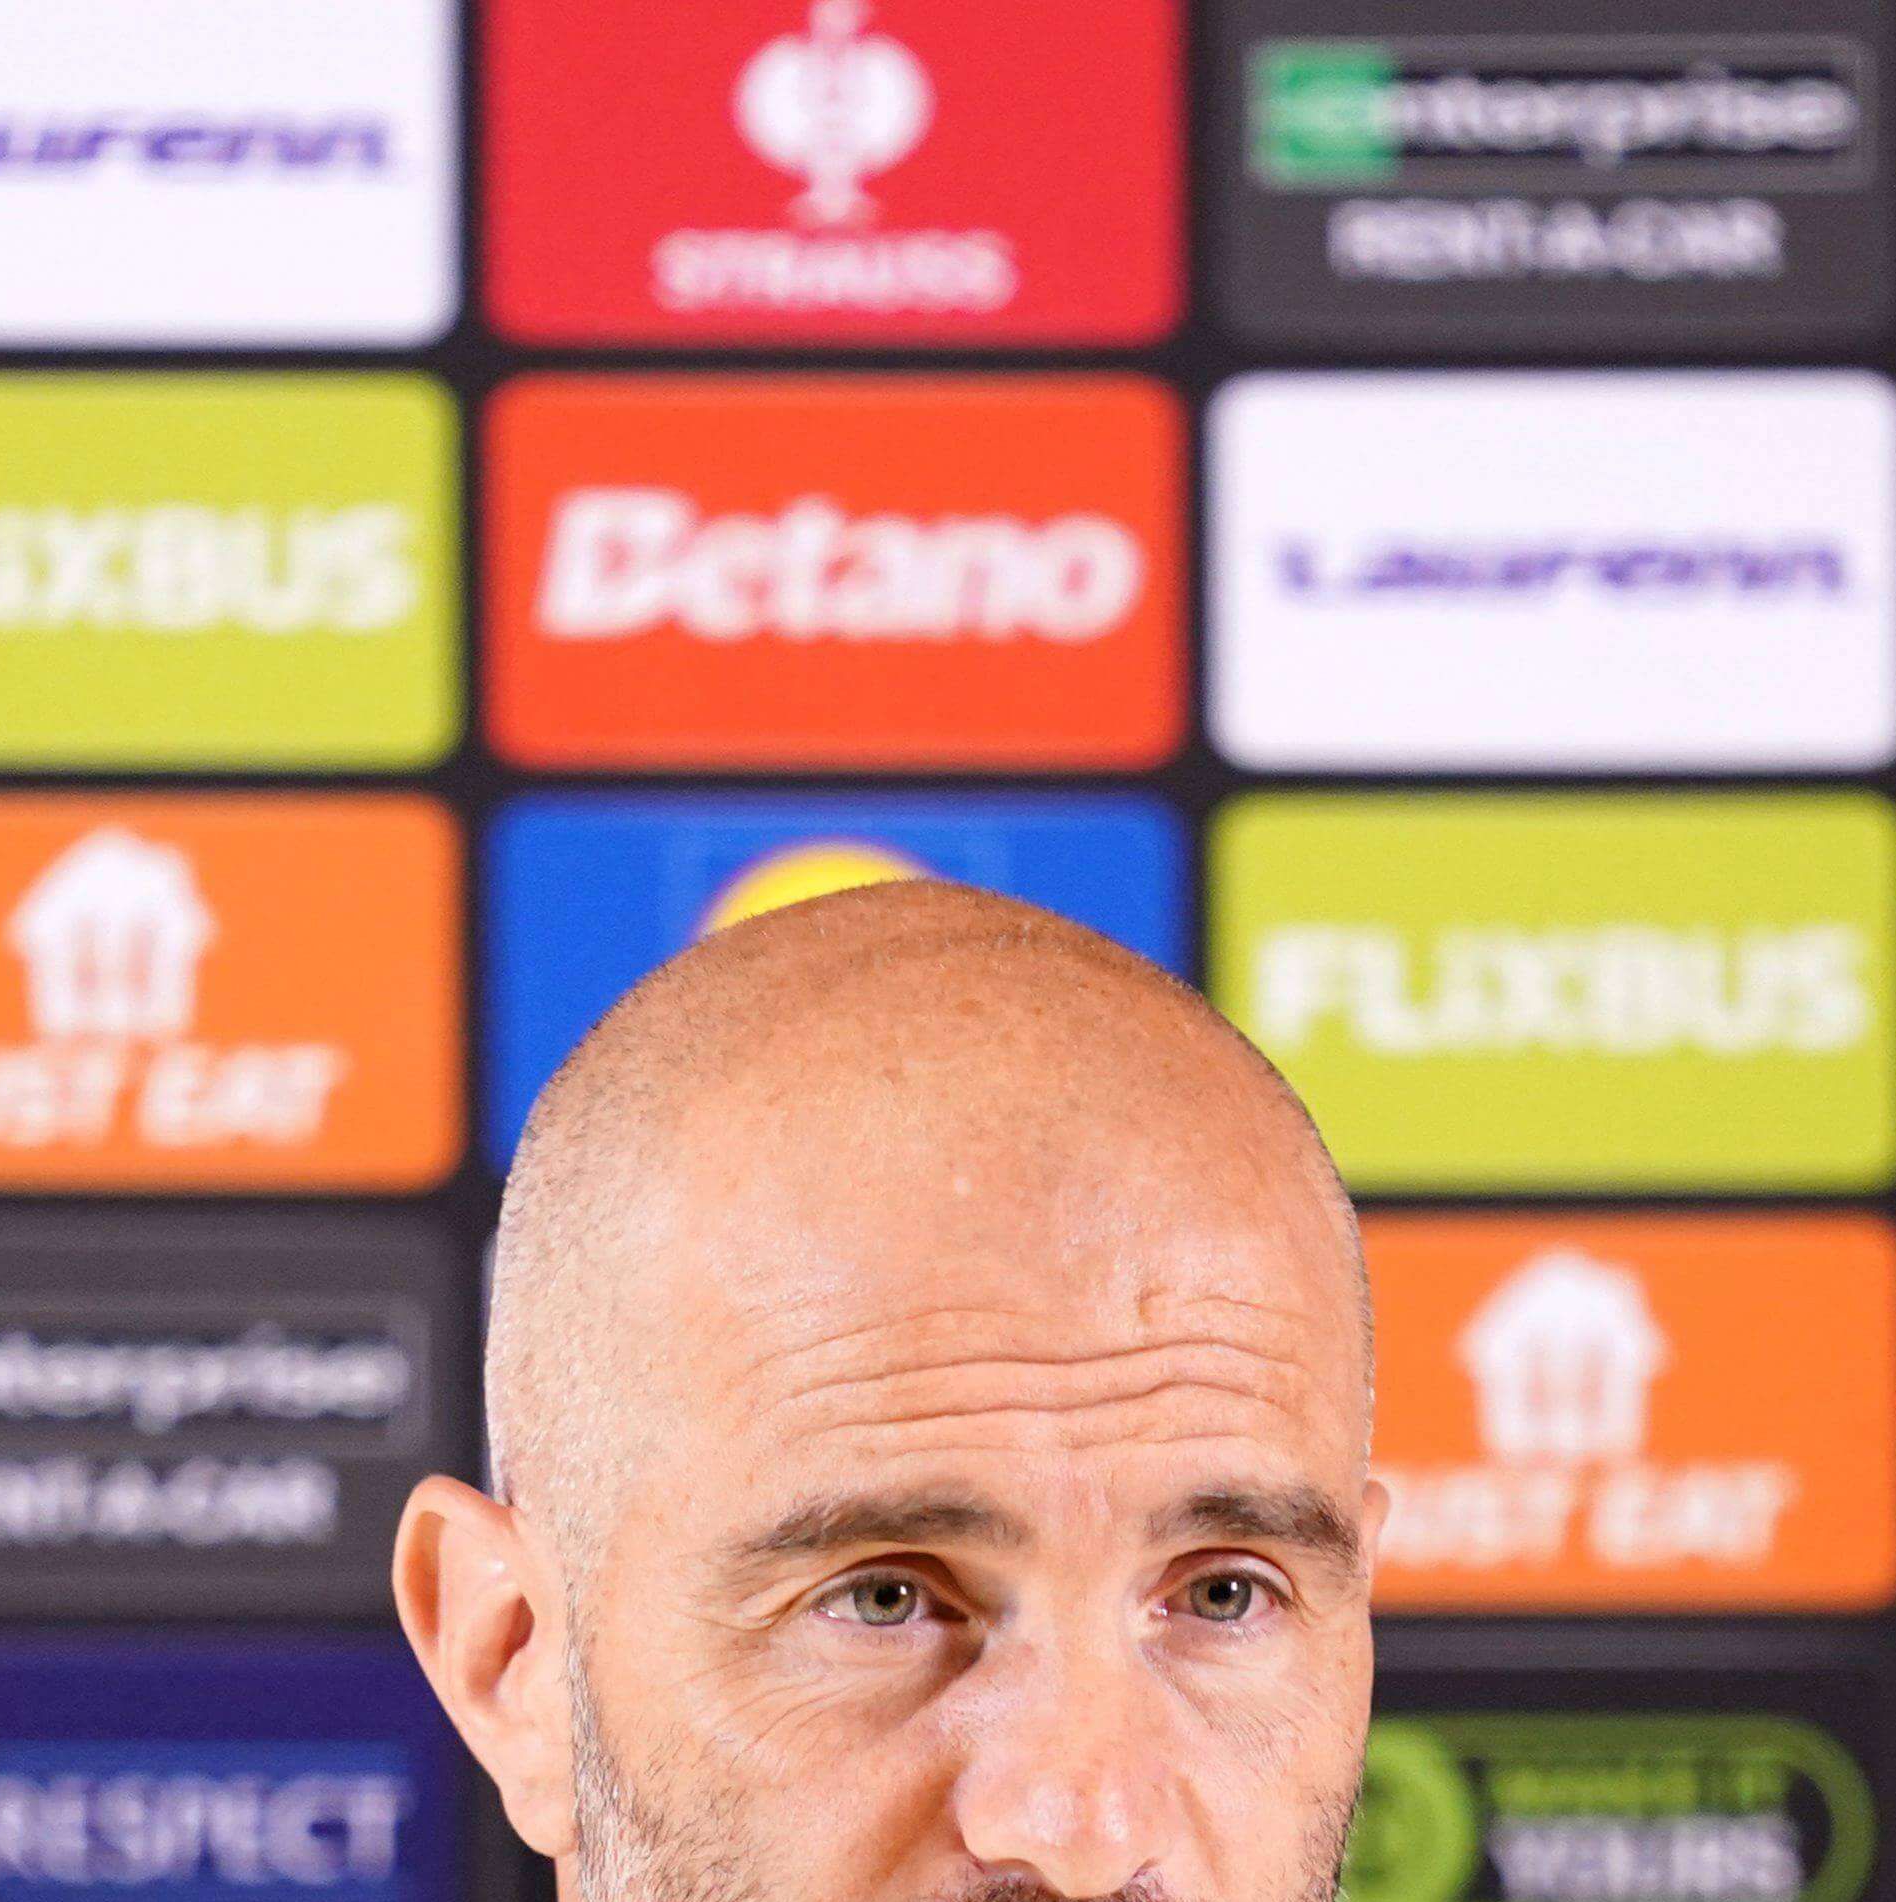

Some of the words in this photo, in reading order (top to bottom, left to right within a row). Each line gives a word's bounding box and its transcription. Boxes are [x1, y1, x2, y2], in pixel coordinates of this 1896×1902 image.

[1308, 65, 1855, 168] enterprise
[656, 231, 1015, 311] STRAUSS
[536, 486, 1145, 641] Betano
[1273, 538, 1851, 600] Laurenn
[138, 1043, 351, 1147] EAT
[1381, 1465, 1579, 1568] UST
[1588, 1460, 1801, 1567] EAT
